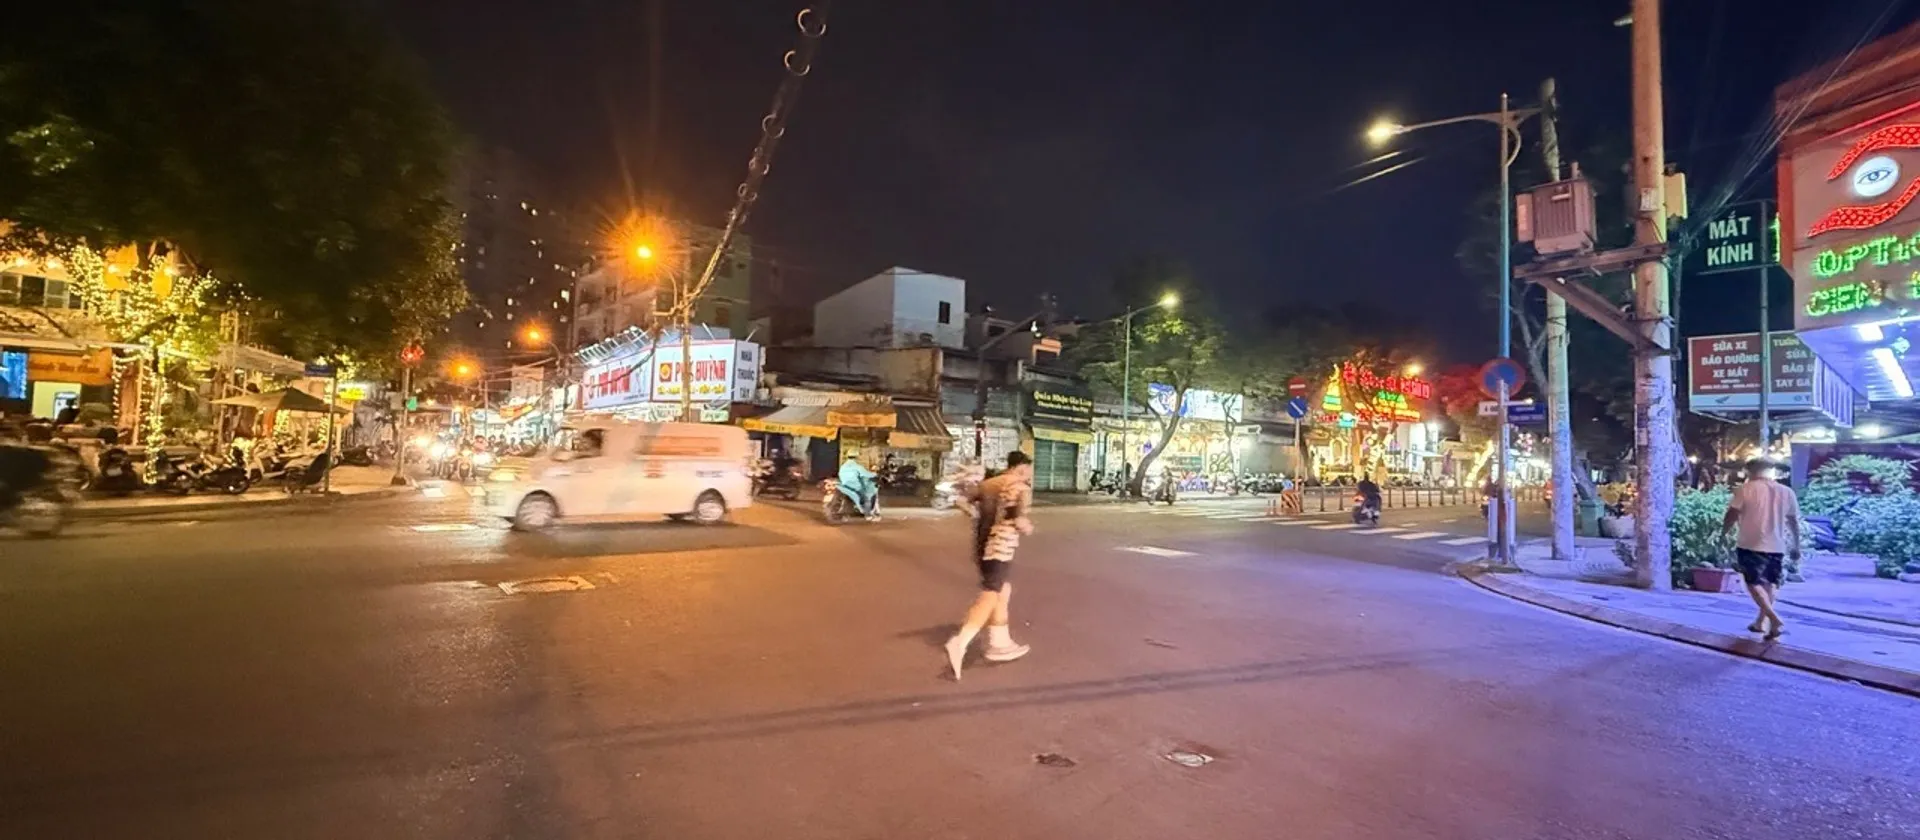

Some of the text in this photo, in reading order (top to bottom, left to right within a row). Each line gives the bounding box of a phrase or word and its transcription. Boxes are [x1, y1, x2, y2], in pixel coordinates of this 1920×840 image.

[1709, 210, 1752, 240] MẮT
[1707, 240, 1753, 267] KÍNH
[1735, 341, 1748, 350] XE
[1713, 369, 1725, 378] XE
